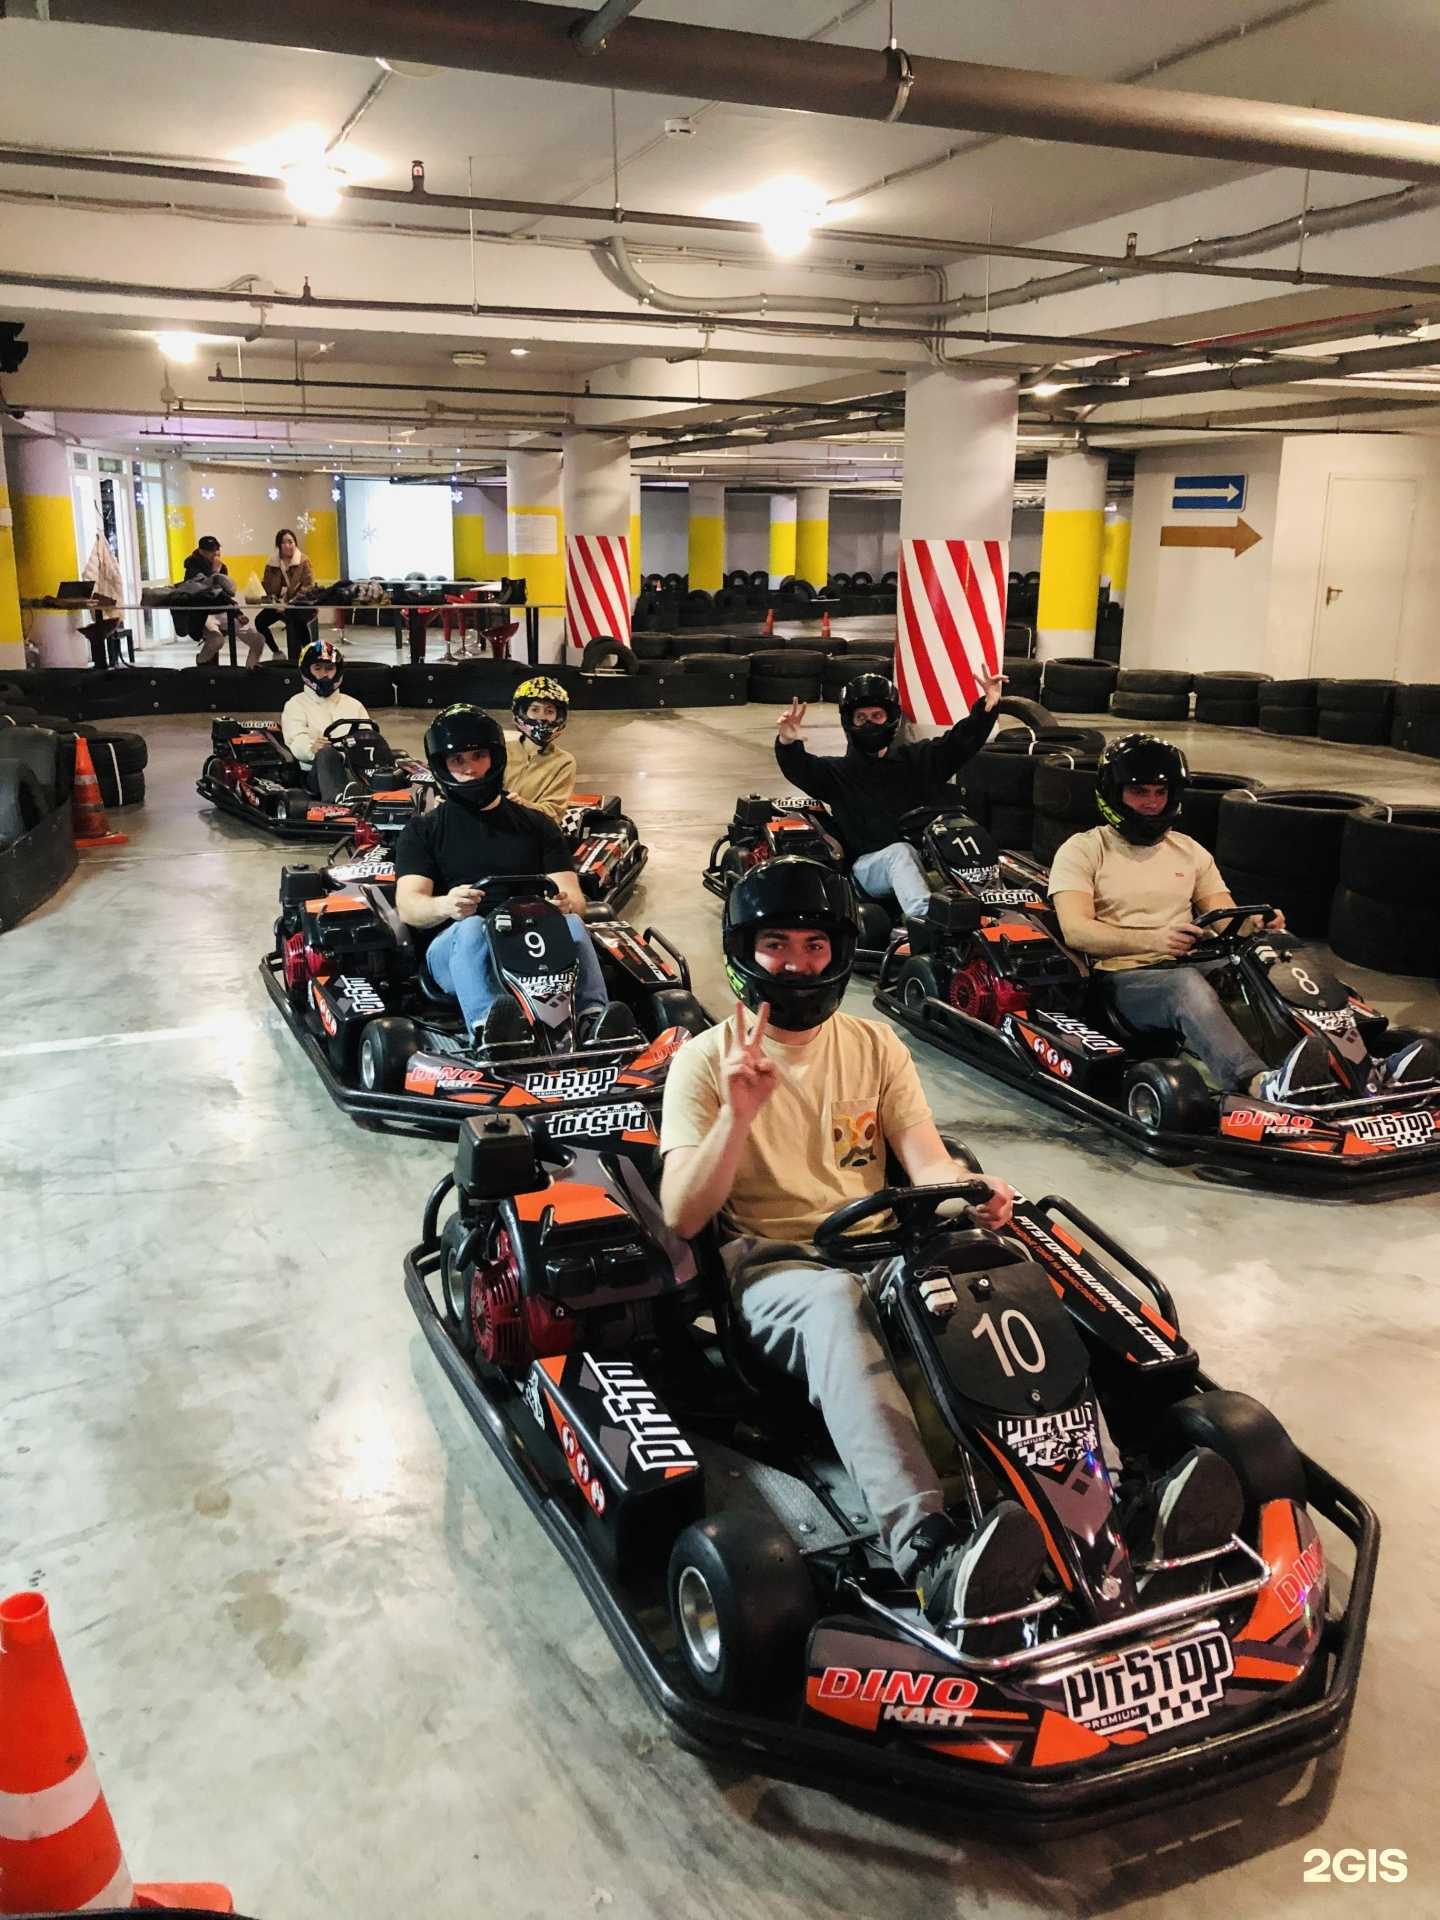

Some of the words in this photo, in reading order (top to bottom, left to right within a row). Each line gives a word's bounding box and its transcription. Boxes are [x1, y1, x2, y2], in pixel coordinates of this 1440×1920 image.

[364, 746, 375, 762] 7
[952, 836, 981, 856] 11
[524, 931, 546, 958] 9
[1291, 967, 1320, 995] 8
[528, 1068, 617, 1092] PITSTOP
[1228, 1110, 1314, 1129] DINO
[1354, 1113, 1433, 1138] PITSTOP
[971, 1309, 1047, 1378] 10
[819, 1667, 978, 1708] DINO
[1067, 1636, 1230, 1718] PITSTOP
[883, 1704, 974, 1728] KART
